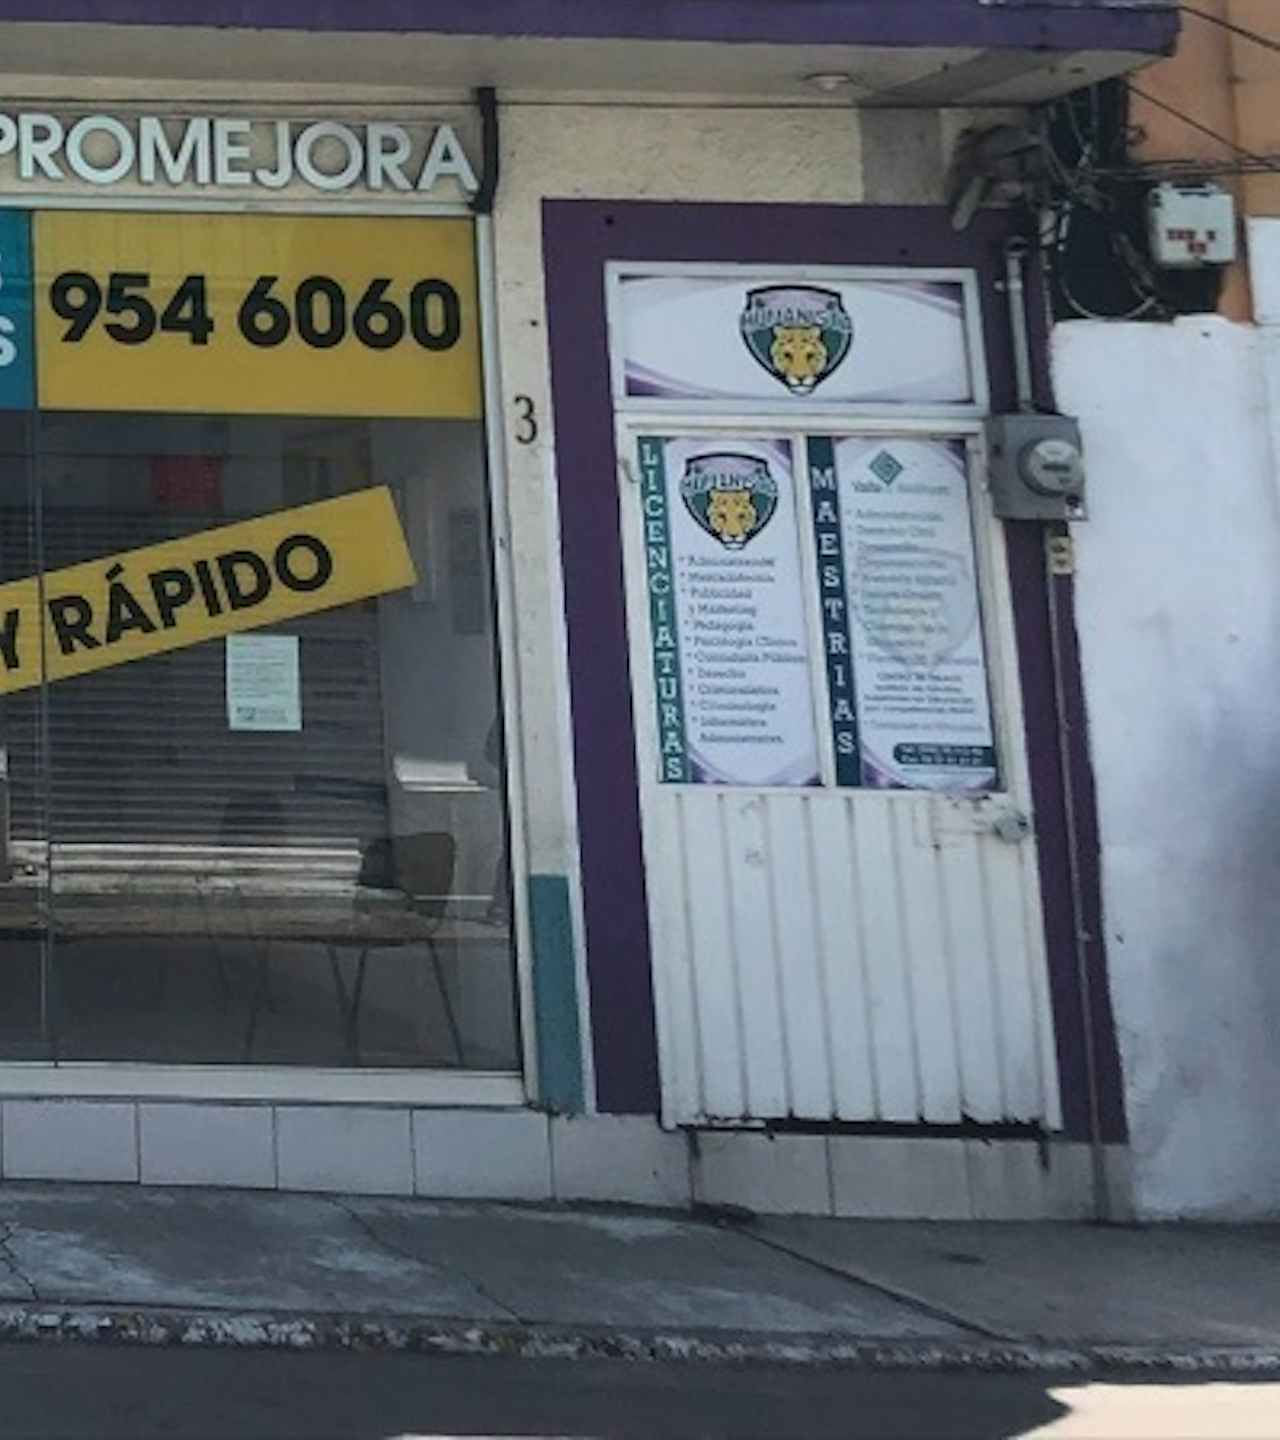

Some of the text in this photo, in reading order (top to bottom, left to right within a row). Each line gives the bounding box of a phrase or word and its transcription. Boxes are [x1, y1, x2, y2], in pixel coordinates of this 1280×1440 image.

[48, 271, 461, 351] 954 6060
[513, 394, 538, 446] 3
[49, 532, 334, 657] RÁPIDO
